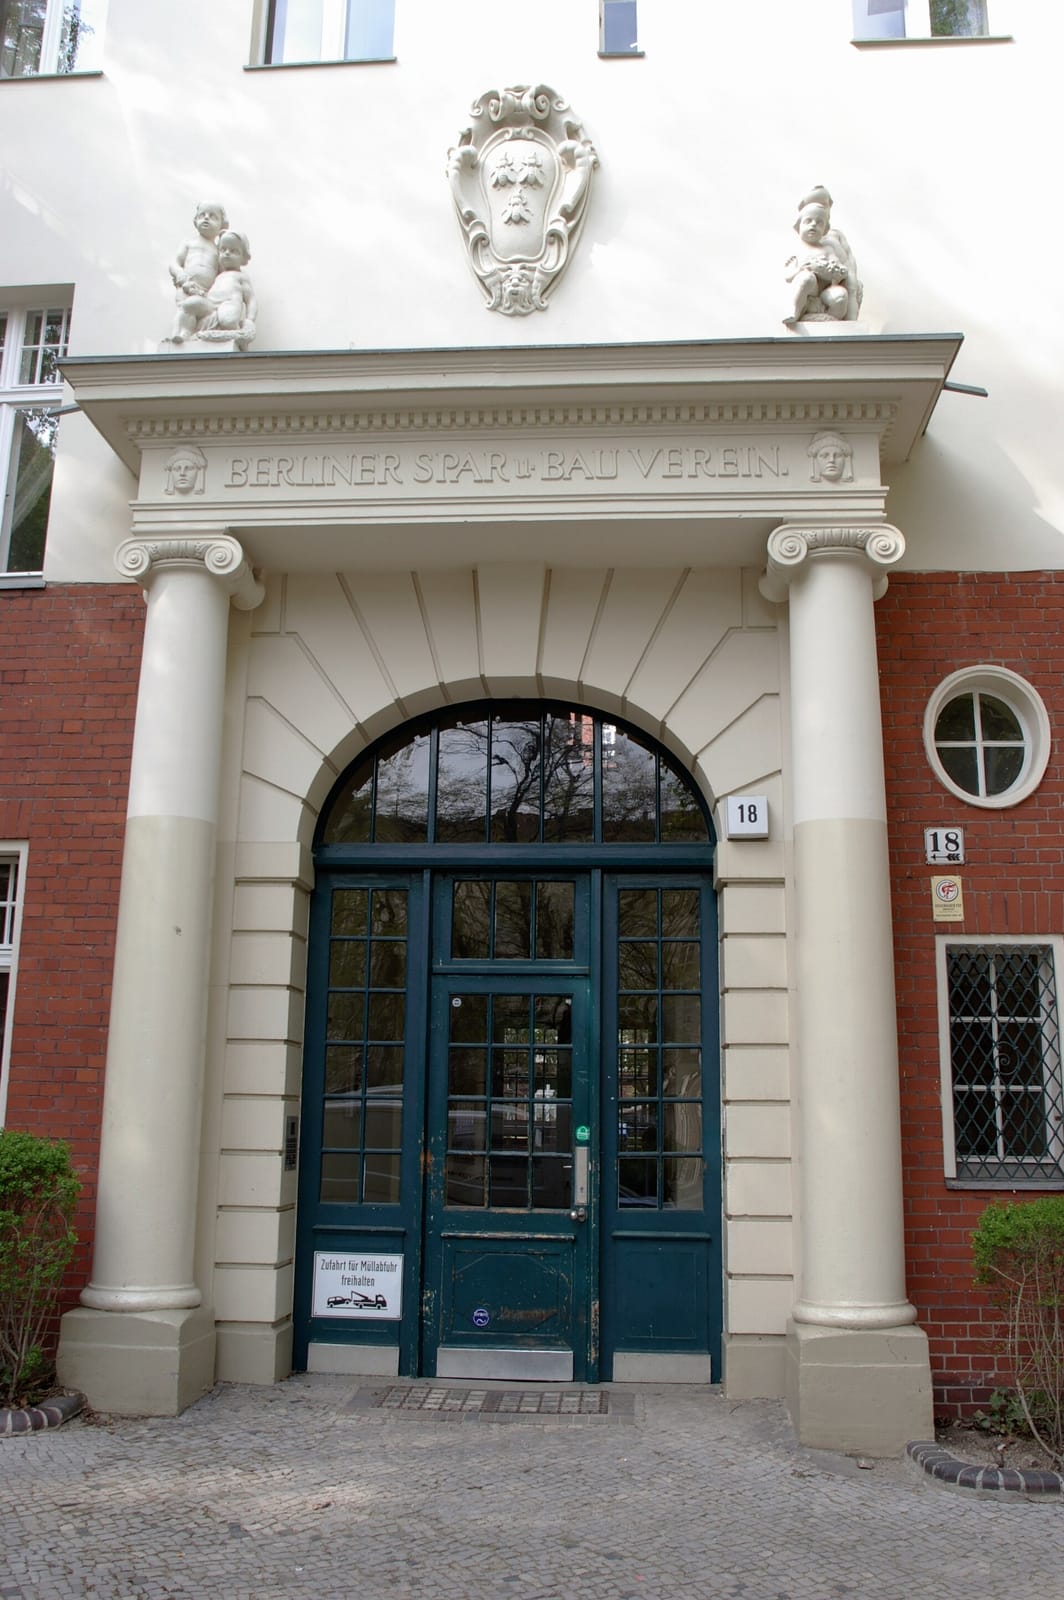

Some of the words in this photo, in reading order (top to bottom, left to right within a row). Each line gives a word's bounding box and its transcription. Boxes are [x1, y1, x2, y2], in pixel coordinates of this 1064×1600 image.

[224, 452, 402, 488] BERLINER
[413, 450, 510, 484] SPAR
[737, 804, 758, 823] 18
[929, 831, 961, 853] 18
[321, 1259, 347, 1271] Zufahrt
[348, 1260, 358, 1271] für
[361, 1261, 397, 1273] Müllabfuhr
[341, 1274, 375, 1287] freihalten
